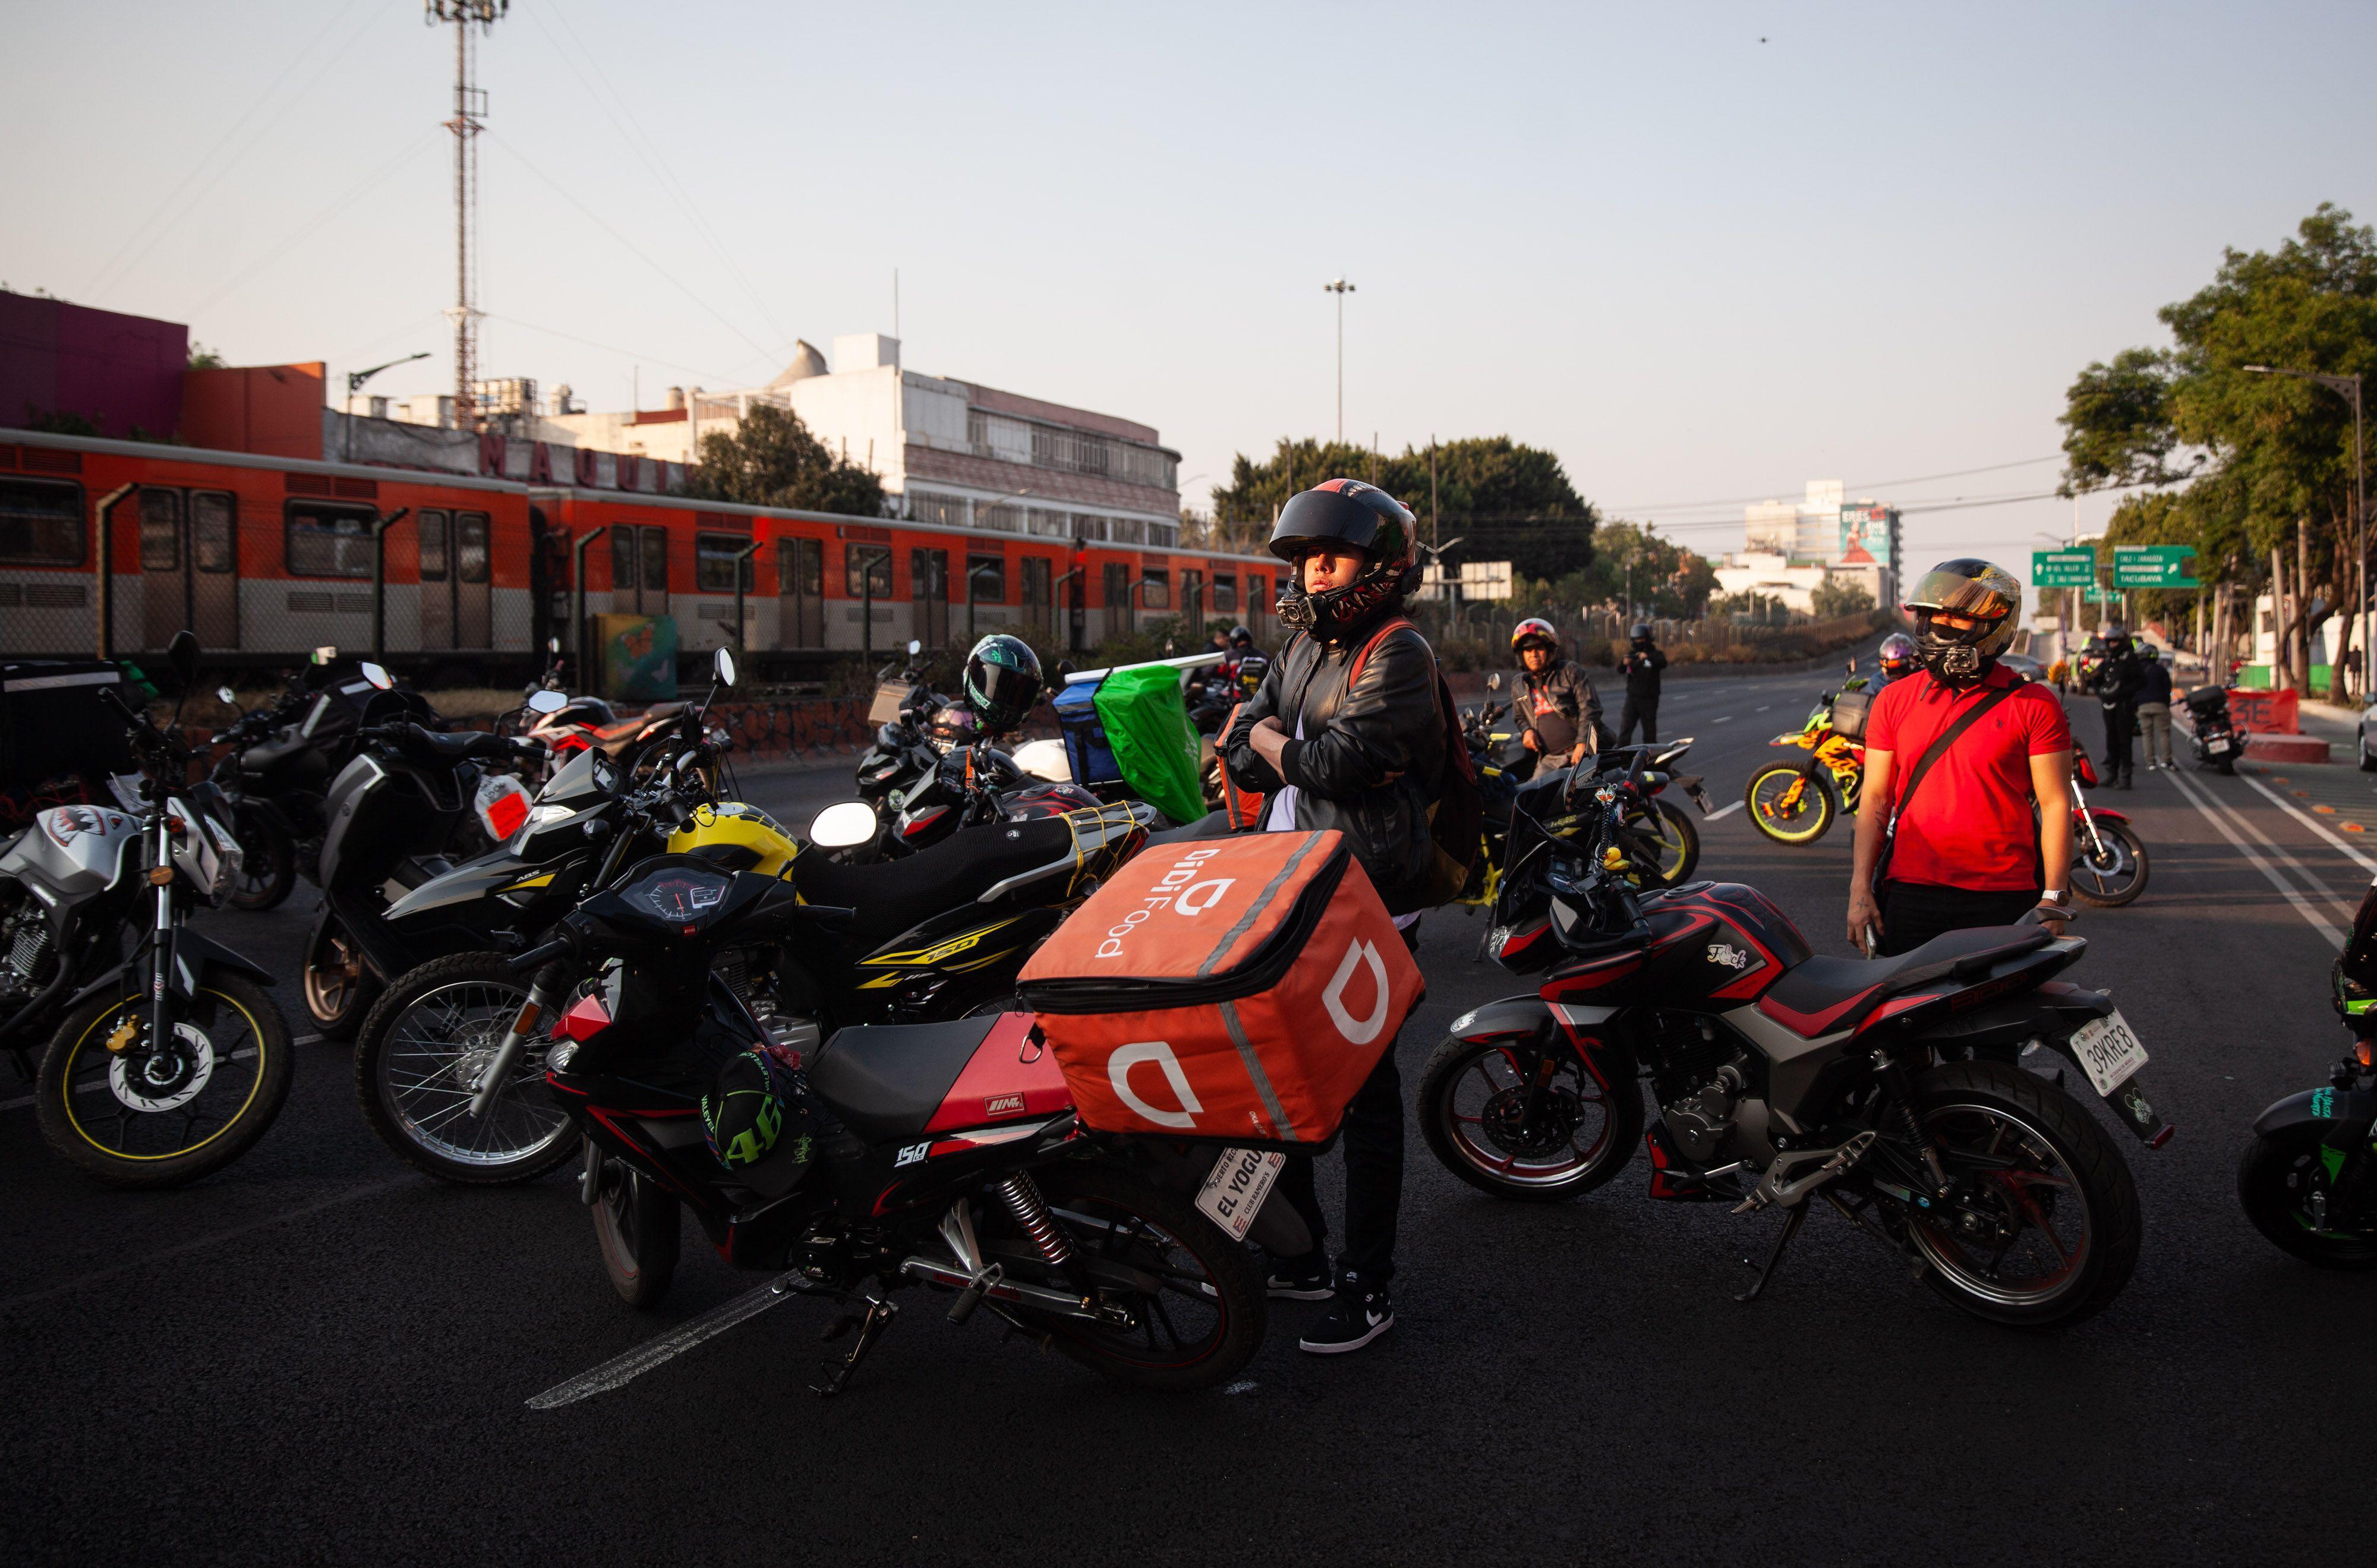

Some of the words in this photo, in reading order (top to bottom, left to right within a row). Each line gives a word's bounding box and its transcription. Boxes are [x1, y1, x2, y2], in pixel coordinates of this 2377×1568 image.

[515, 869, 540, 883] ABS
[1095, 896, 1172, 958] Food
[926, 939, 974, 961] 150
[1708, 945, 1745, 967] Fck
[2087, 1025, 2133, 1074] 39KRE8
[2113, 1066, 2122, 1076] CIUDAD
[727, 1094, 782, 1163] 46
[894, 1141, 932, 1168] 150
[1217, 1195, 1238, 1218] EL
[1228, 1150, 1266, 1195] YOGU
[1244, 1200, 1254, 1214] CLUB
[1251, 1171, 1270, 1200] RAMERO'S
